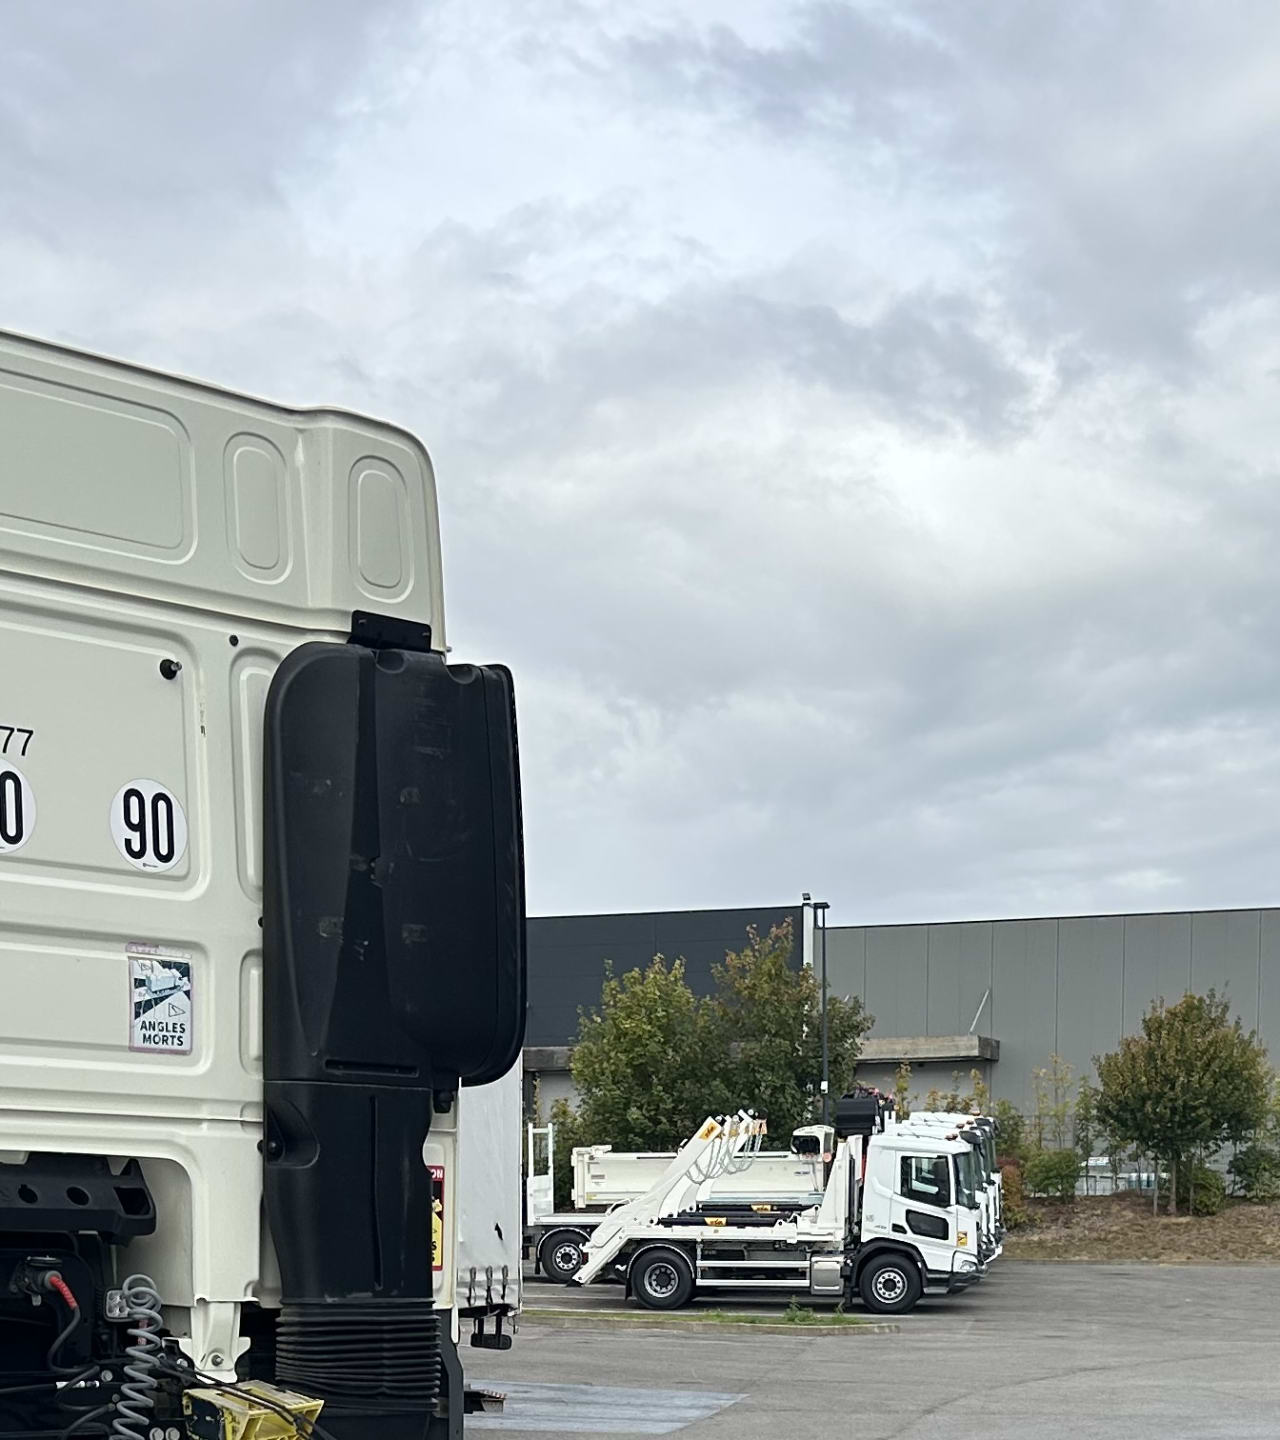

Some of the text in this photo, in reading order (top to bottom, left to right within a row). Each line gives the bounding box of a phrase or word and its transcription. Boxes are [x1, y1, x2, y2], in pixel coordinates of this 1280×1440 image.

[123, 787, 176, 864] 90
[140, 1020, 186, 1034] ANGLES
[142, 1033, 184, 1047] MORTS
